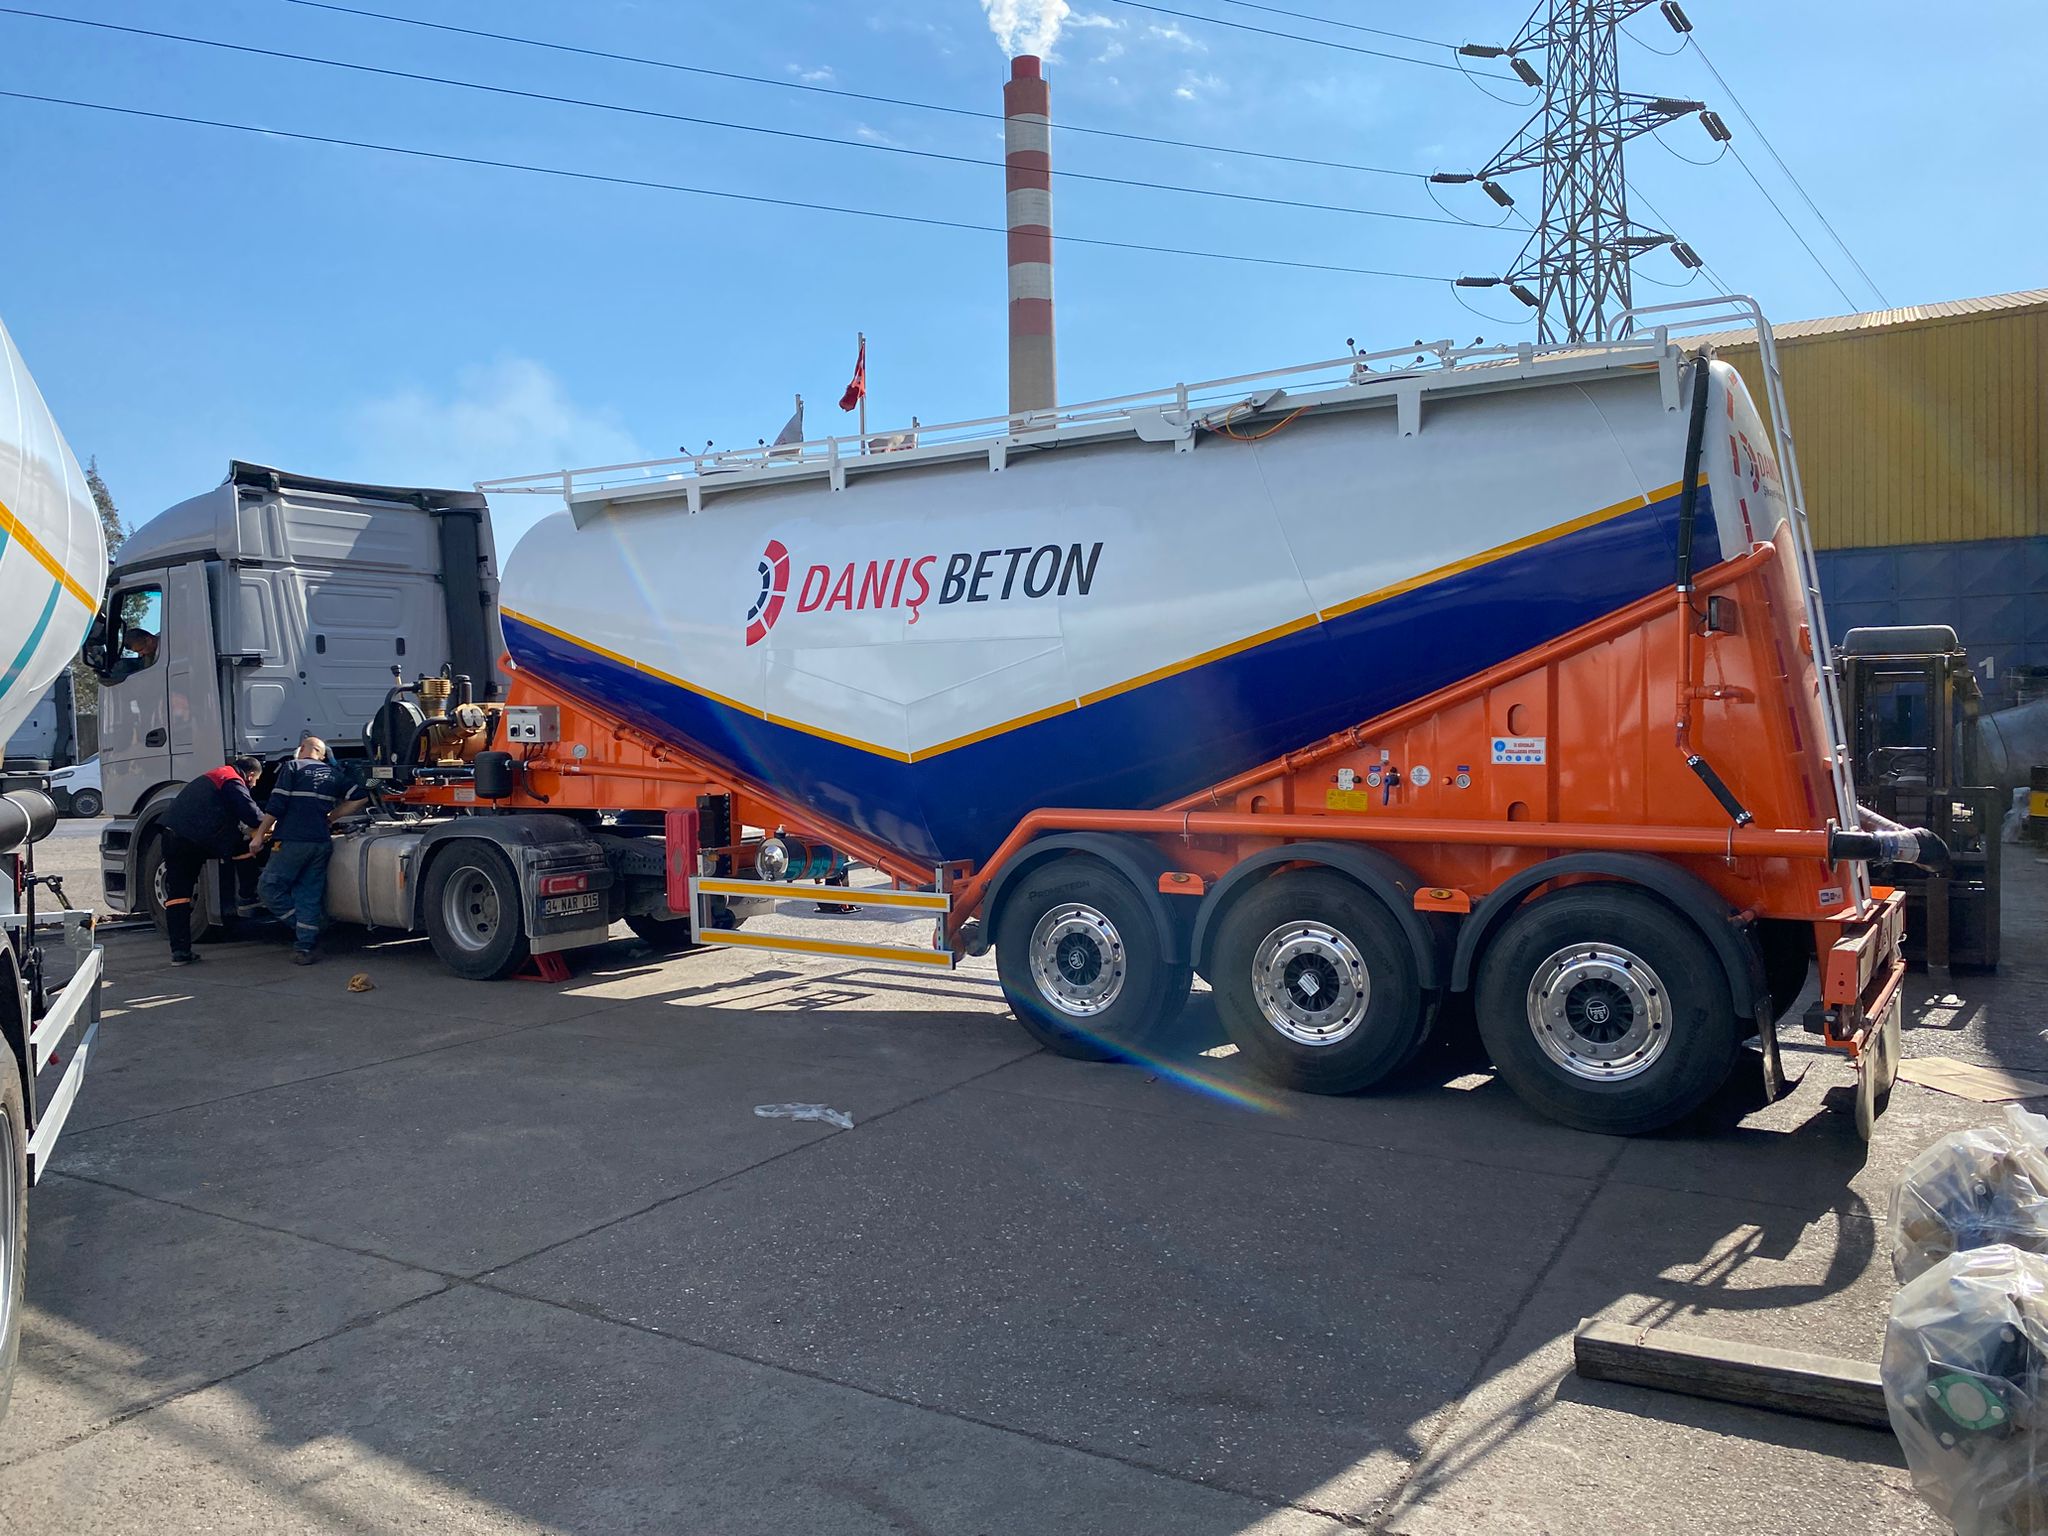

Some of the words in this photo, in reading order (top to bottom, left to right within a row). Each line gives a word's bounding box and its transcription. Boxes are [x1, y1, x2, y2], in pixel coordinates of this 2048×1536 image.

[797, 555, 937, 625] DANIŞ
[939, 542, 1104, 605] BETON
[1979, 656, 1995, 679] 1
[546, 900, 558, 913] 34
[561, 896, 578, 911] NAR
[582, 893, 598, 908] 015
